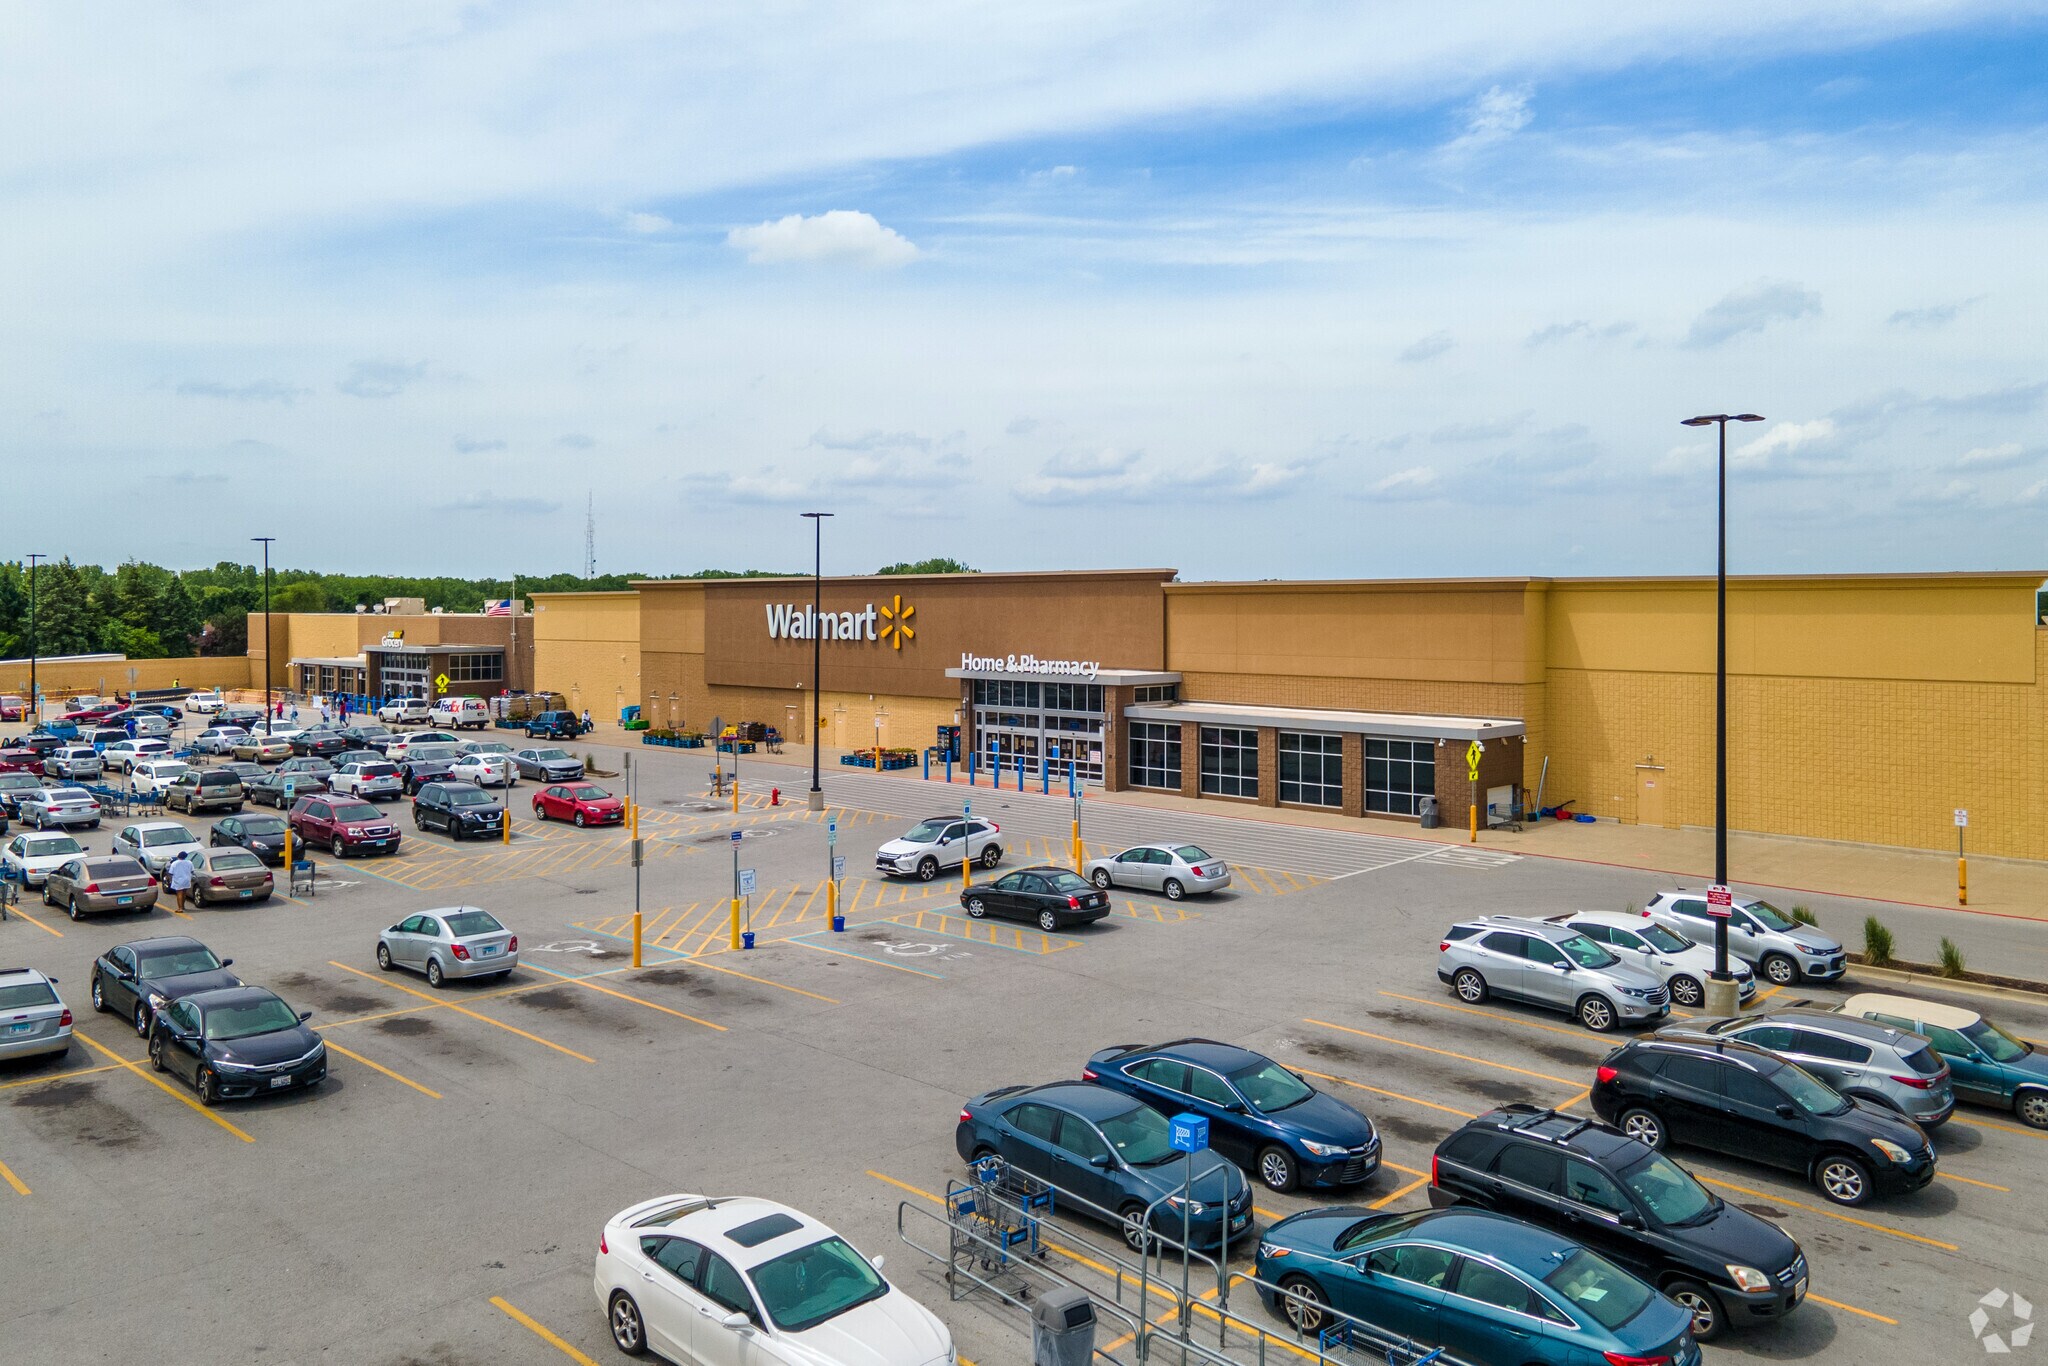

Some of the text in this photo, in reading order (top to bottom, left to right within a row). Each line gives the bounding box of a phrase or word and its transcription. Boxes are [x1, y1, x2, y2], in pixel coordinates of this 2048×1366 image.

[765, 603, 878, 641] Walmart
[381, 635, 404, 651] Grocery
[961, 652, 1100, 681] Home & Pharmacy
[440, 700, 460, 713] FedEx
[465, 702, 486, 711] FedEx
